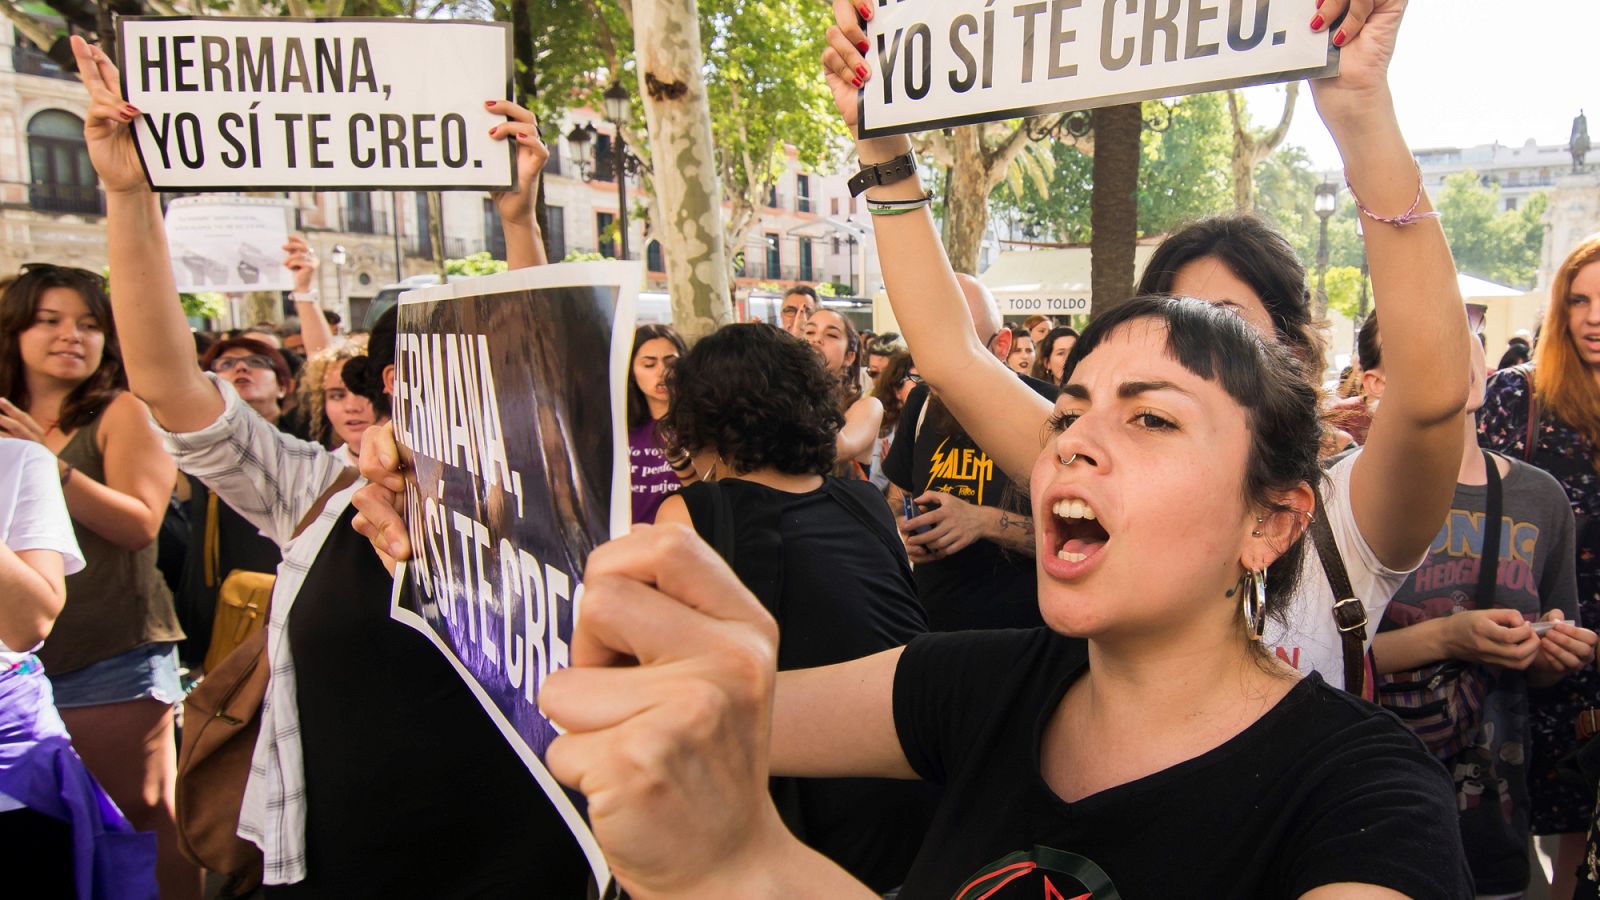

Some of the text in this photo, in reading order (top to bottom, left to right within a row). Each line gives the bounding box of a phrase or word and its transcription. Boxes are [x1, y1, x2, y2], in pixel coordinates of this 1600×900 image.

[139, 36, 391, 101] HERMANA,
[877, 0, 1286, 104] YO SÍ TE CREO.
[142, 101, 482, 169] YO SÍ TE CREO.
[1009, 298, 1041, 309] TODO
[1046, 298, 1086, 309] TOLDO
[631, 483, 647, 493] er
[426, 480, 457, 626] SÍ
[453, 511, 497, 665] TE
[500, 538, 584, 736] CRE
